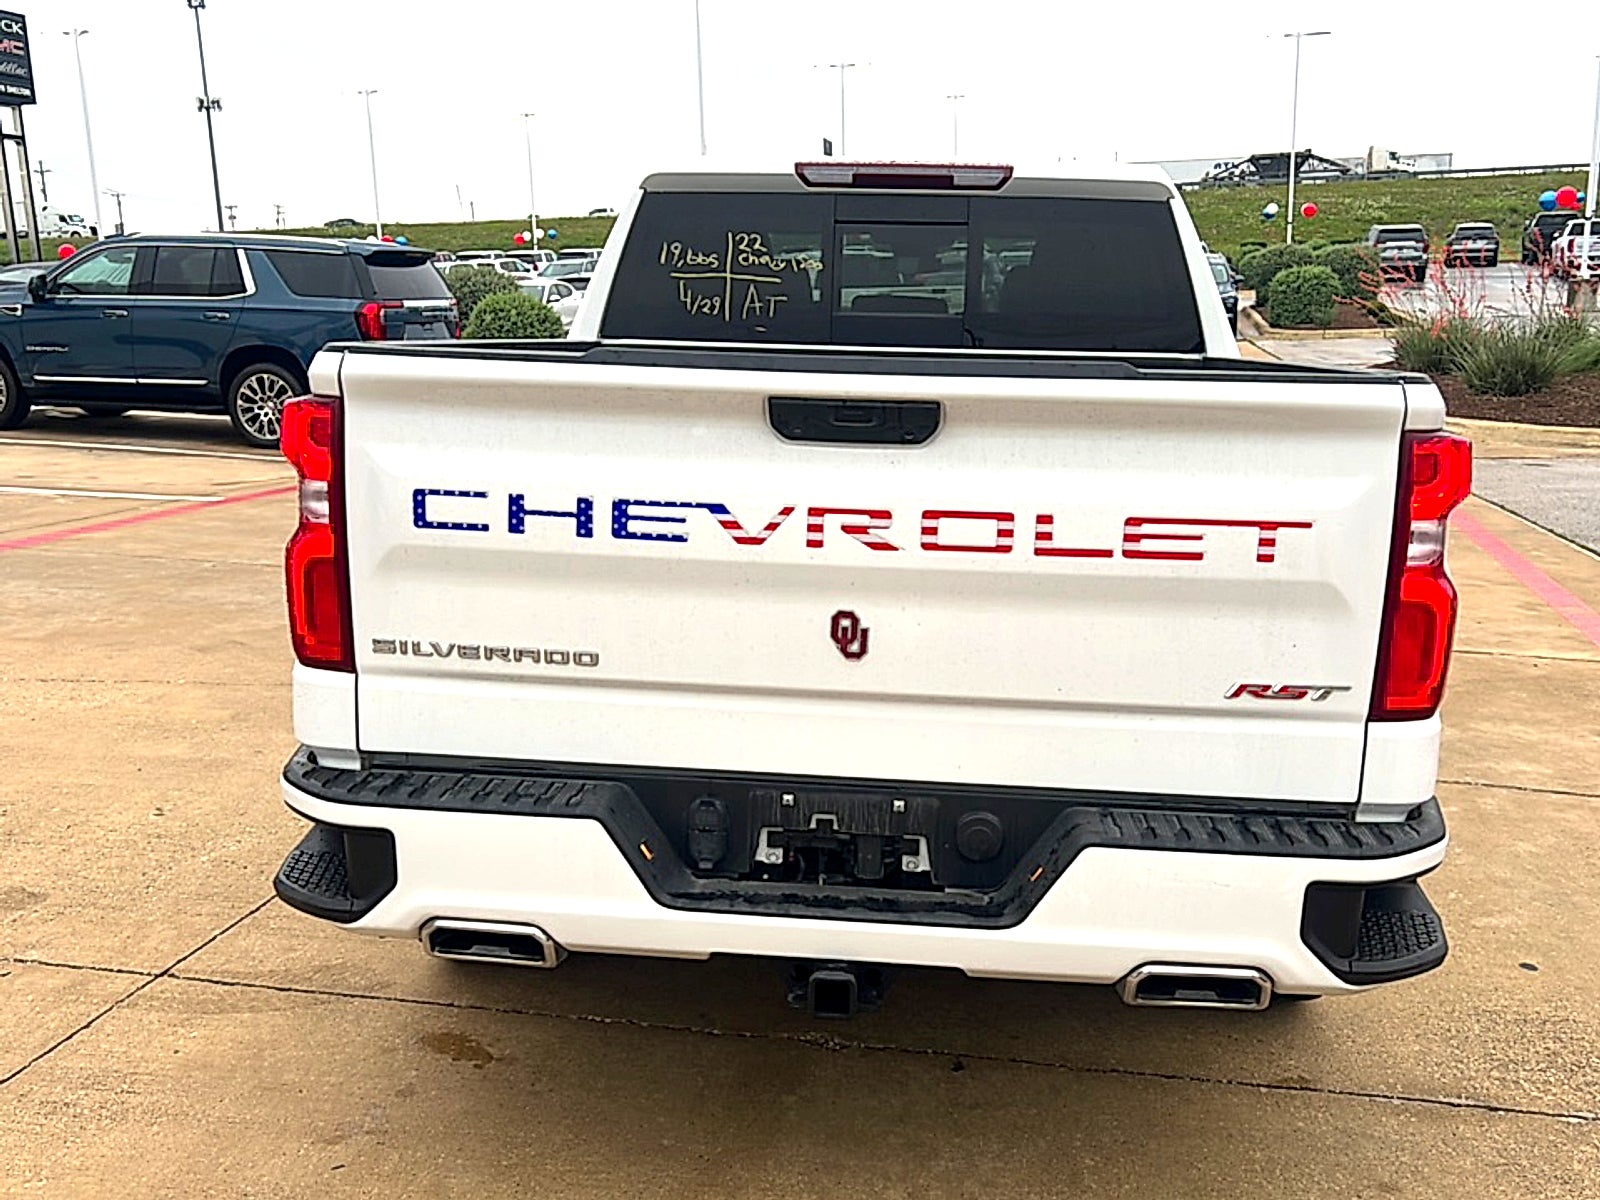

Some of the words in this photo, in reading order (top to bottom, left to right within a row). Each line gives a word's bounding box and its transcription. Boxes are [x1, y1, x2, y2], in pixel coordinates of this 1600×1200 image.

[1, 19, 24, 35] CK
[734, 232, 768, 252] 22
[679, 279, 721, 315] 4/29
[412, 488, 1313, 563] CHEVROLET
[830, 609, 870, 661] OU
[372, 638, 600, 667] SILVERADO
[1223, 681, 1352, 701] RST
